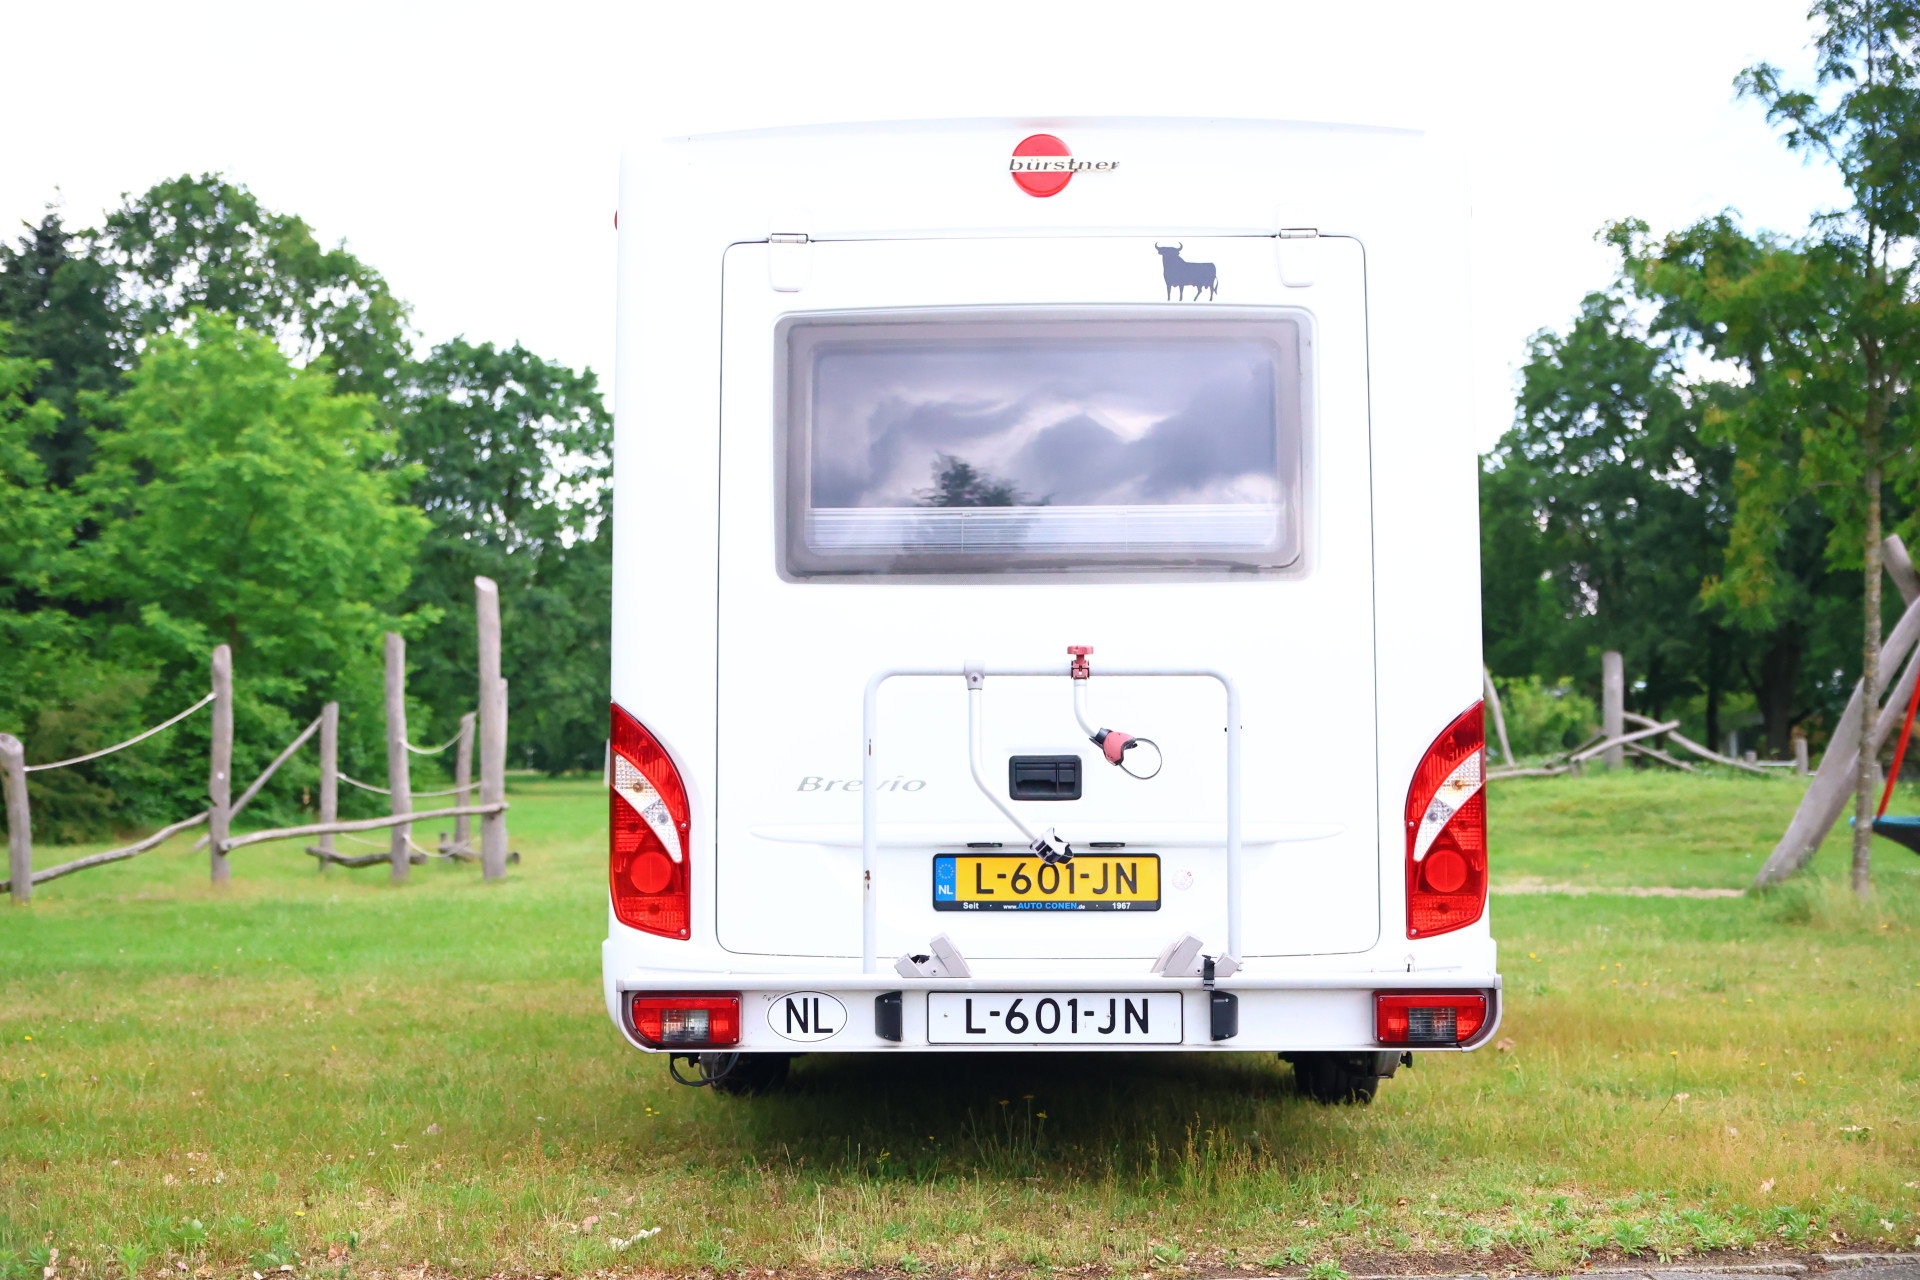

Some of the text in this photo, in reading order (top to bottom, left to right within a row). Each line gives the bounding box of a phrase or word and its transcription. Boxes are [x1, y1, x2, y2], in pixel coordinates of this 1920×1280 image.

[1009, 158, 1120, 171] bürstner
[938, 885, 954, 895] NL
[976, 862, 1138, 895] L-601-JN
[786, 997, 834, 1033] NL
[965, 997, 1149, 1035] L-601-JN
